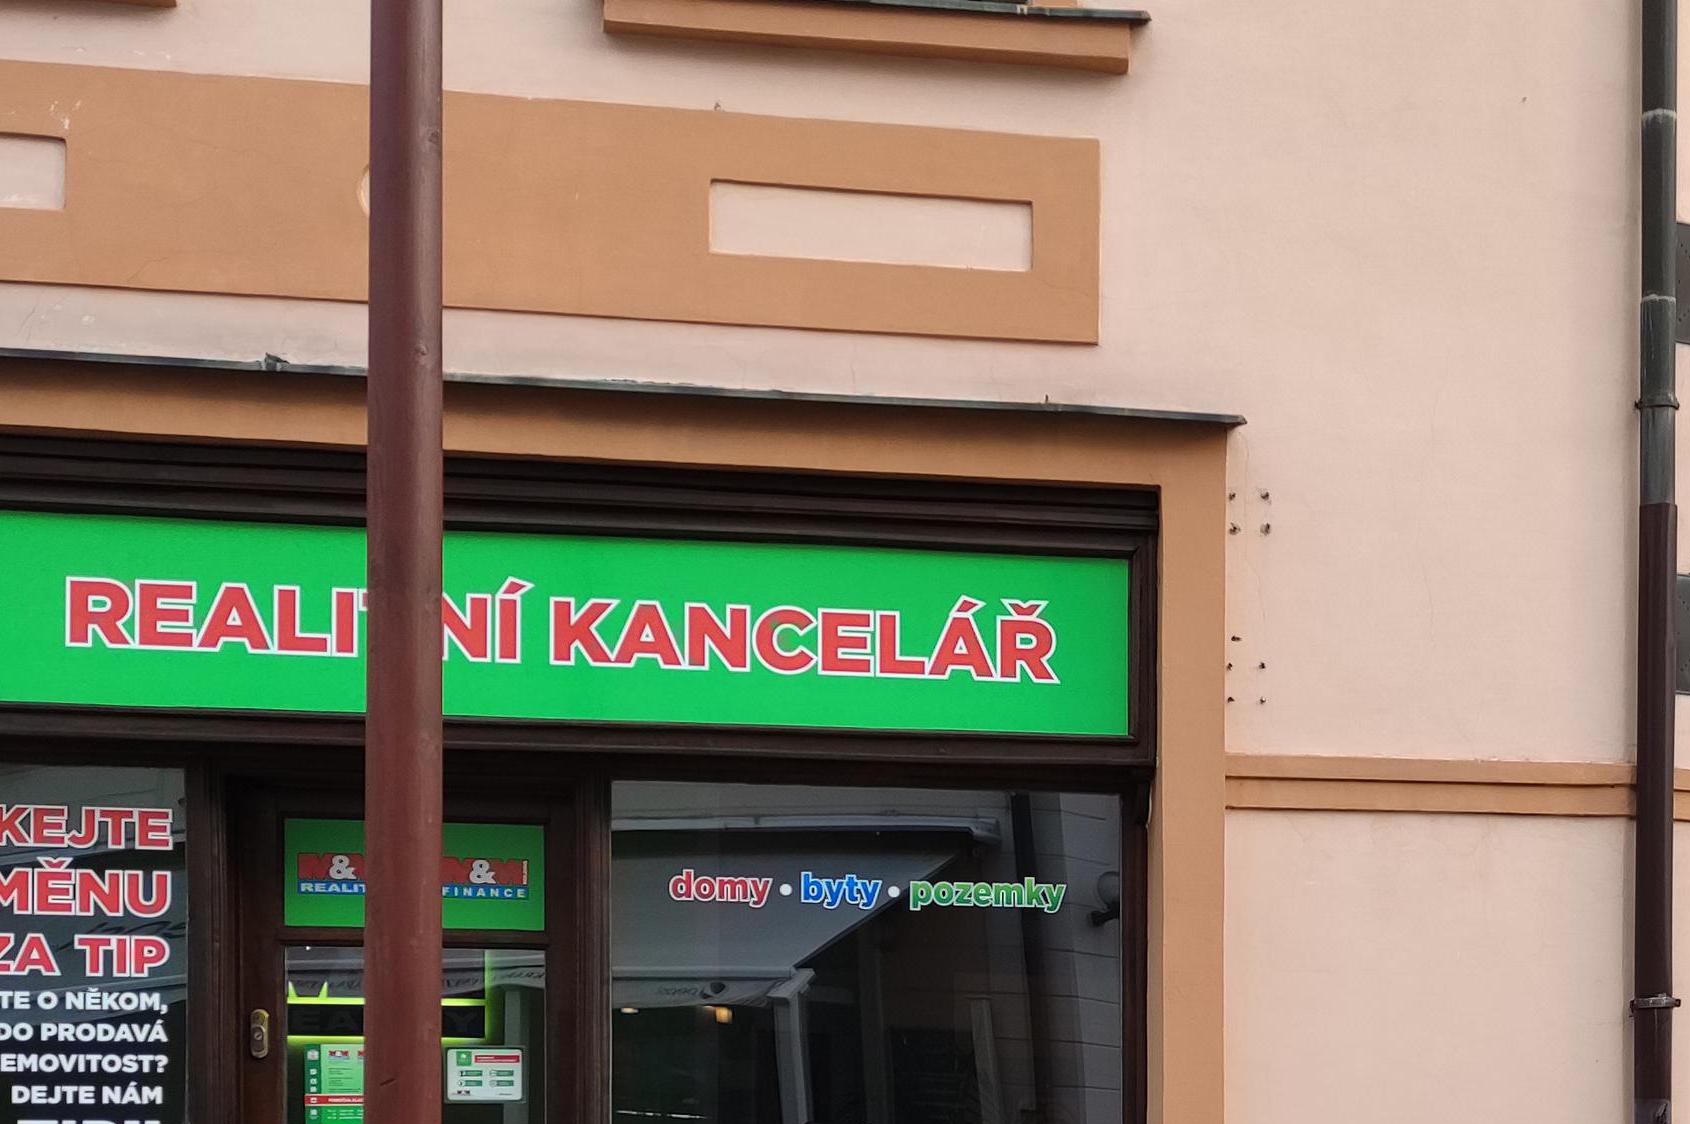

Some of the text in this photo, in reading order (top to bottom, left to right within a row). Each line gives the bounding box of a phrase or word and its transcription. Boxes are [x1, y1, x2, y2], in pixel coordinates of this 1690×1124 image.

[65, 576, 1061, 684] REALINÍ KANCELÁŘ
[0, 804, 174, 851] KEJTE
[0, 857, 172, 918] MĚNU
[300, 882, 365, 893] REALIT
[442, 886, 526, 899] FINANCE
[668, 869, 1067, 914] domy byty pozemky
[74, 933, 170, 977] TIP
[37, 991, 58, 1010] O
[65, 987, 168, 1015] NĚKOM,
[40, 1019, 169, 1043] PRODAVÁ
[0, 1053, 169, 1074] EMOVITOST?
[11, 1081, 163, 1105] DEJTE NÁM
